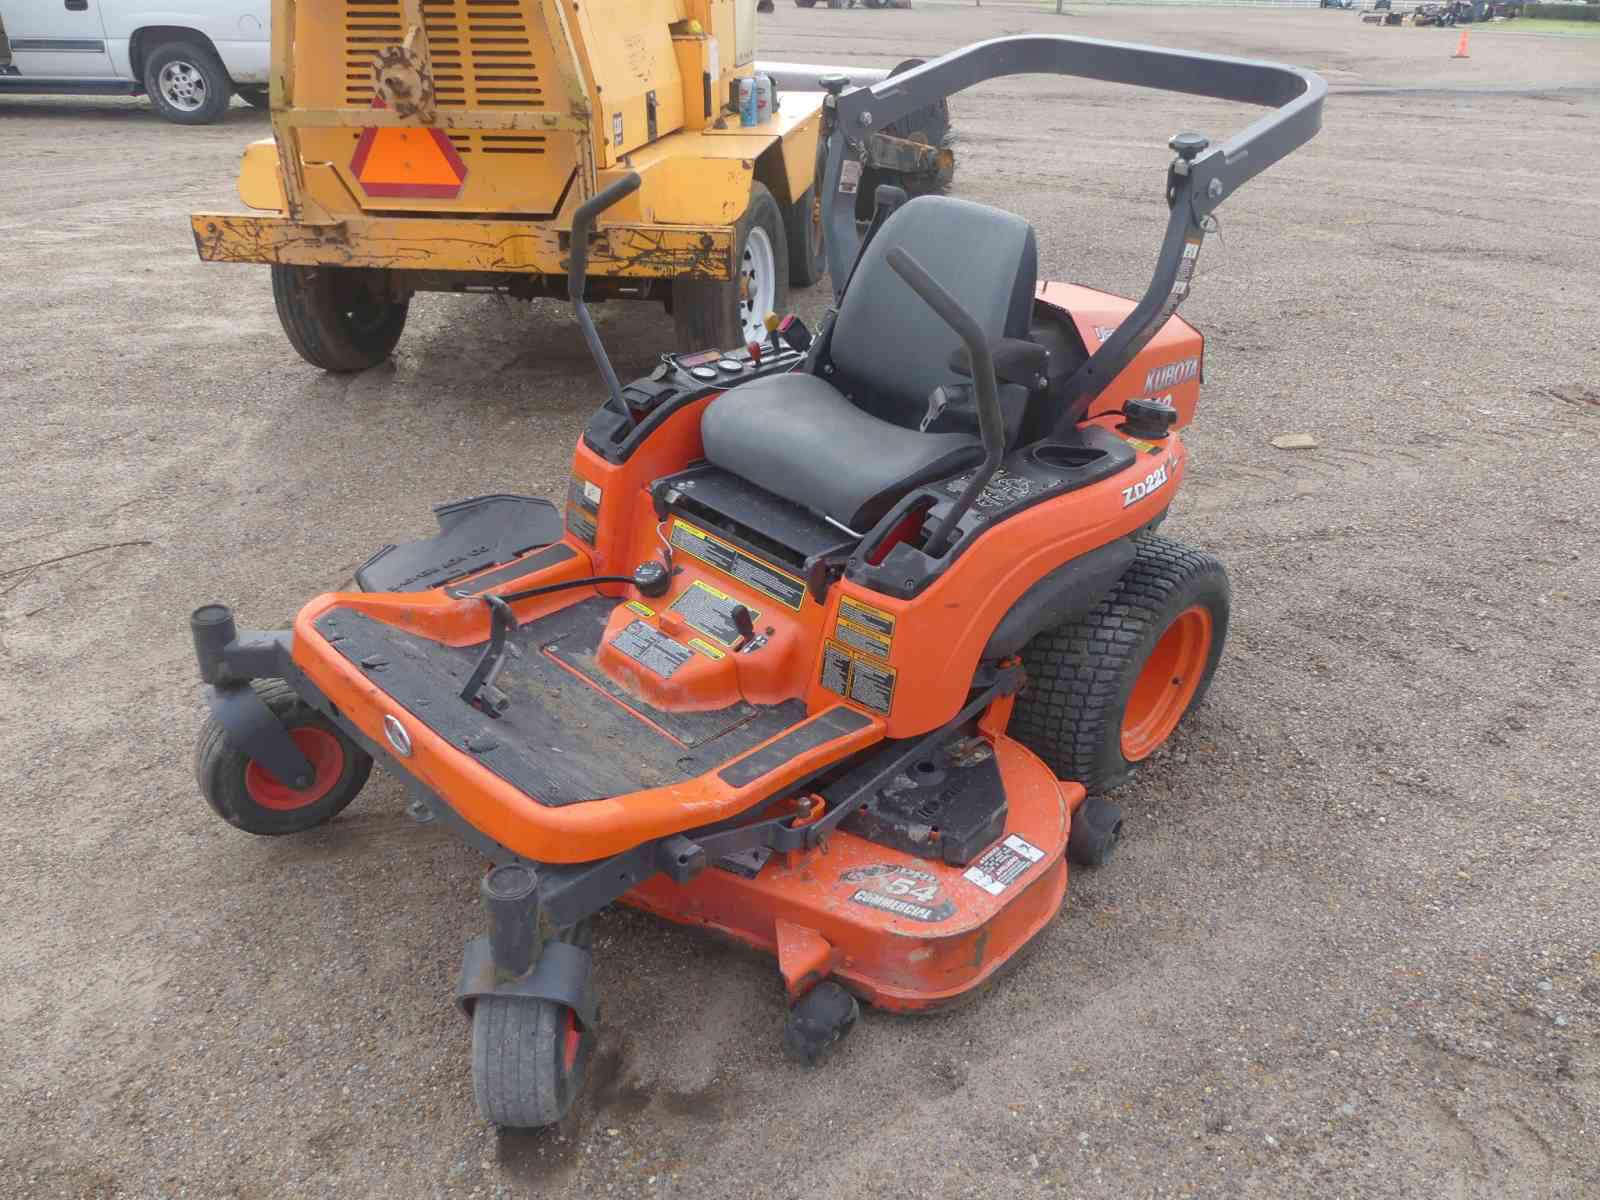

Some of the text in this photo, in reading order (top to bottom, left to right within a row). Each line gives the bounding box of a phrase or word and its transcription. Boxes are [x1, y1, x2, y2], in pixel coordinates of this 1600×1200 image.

[1145, 359, 1198, 392] KUBOTA
[854, 890, 933, 920] COMMERCIAL
[886, 879, 937, 901] 54
